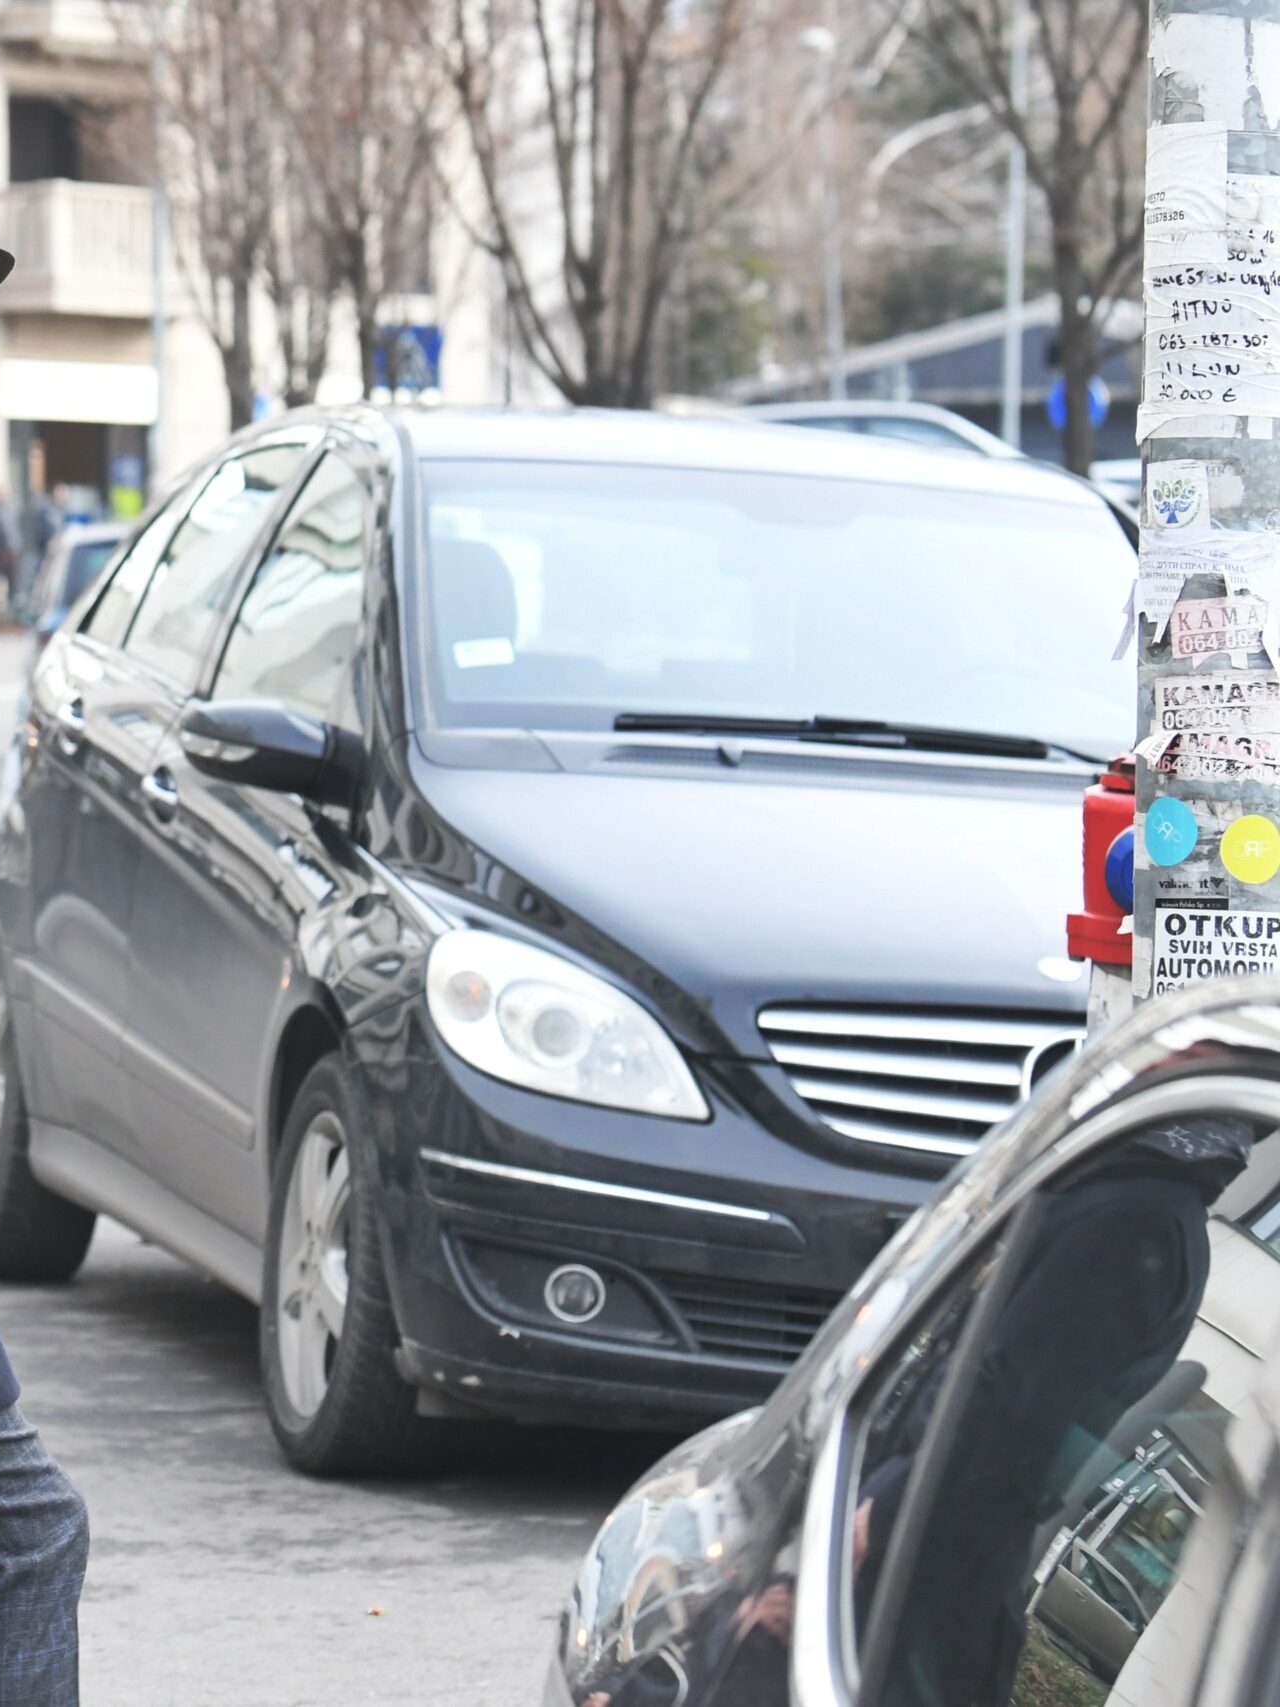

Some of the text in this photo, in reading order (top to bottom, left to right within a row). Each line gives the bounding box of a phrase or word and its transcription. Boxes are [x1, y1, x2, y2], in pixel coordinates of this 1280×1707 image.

[1164, 913, 1280, 939] OTKUP
[1169, 939, 1278, 957] SVIH VRSTA
